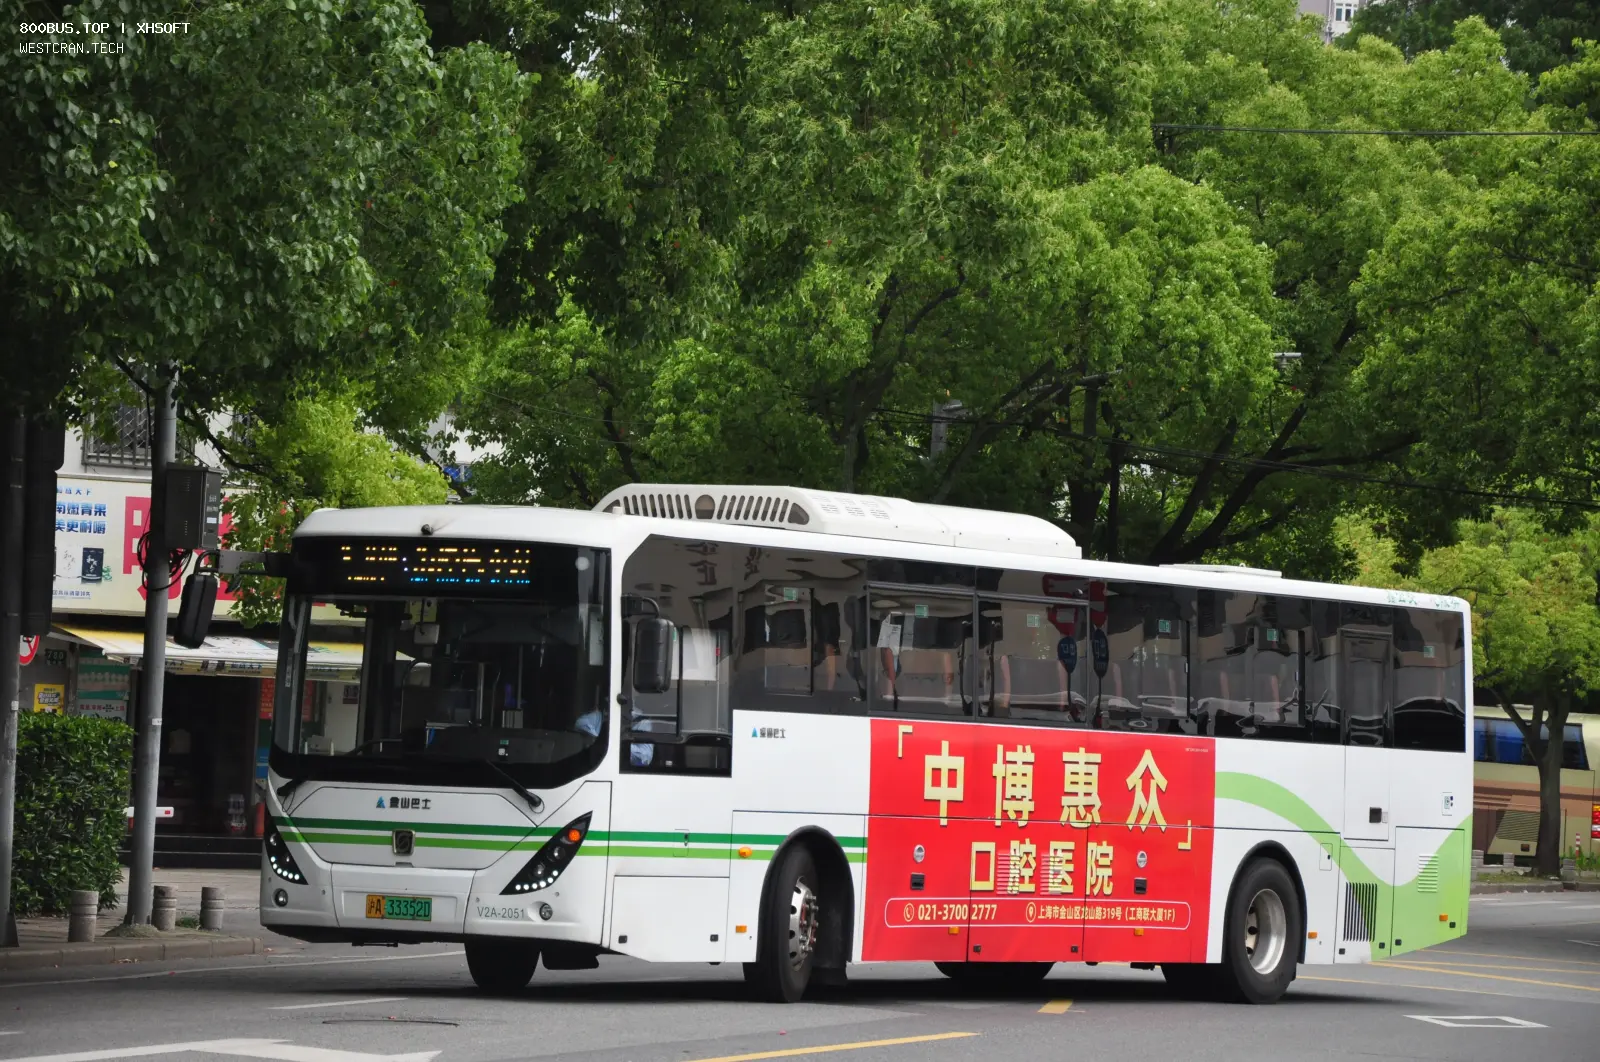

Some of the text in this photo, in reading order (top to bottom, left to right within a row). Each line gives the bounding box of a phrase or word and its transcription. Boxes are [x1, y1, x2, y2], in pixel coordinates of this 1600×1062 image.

[970, 838, 1114, 896] 口腔医院
[476, 906, 526, 919] V2A-2051
[917, 903, 998, 921] 021-3700 2777
